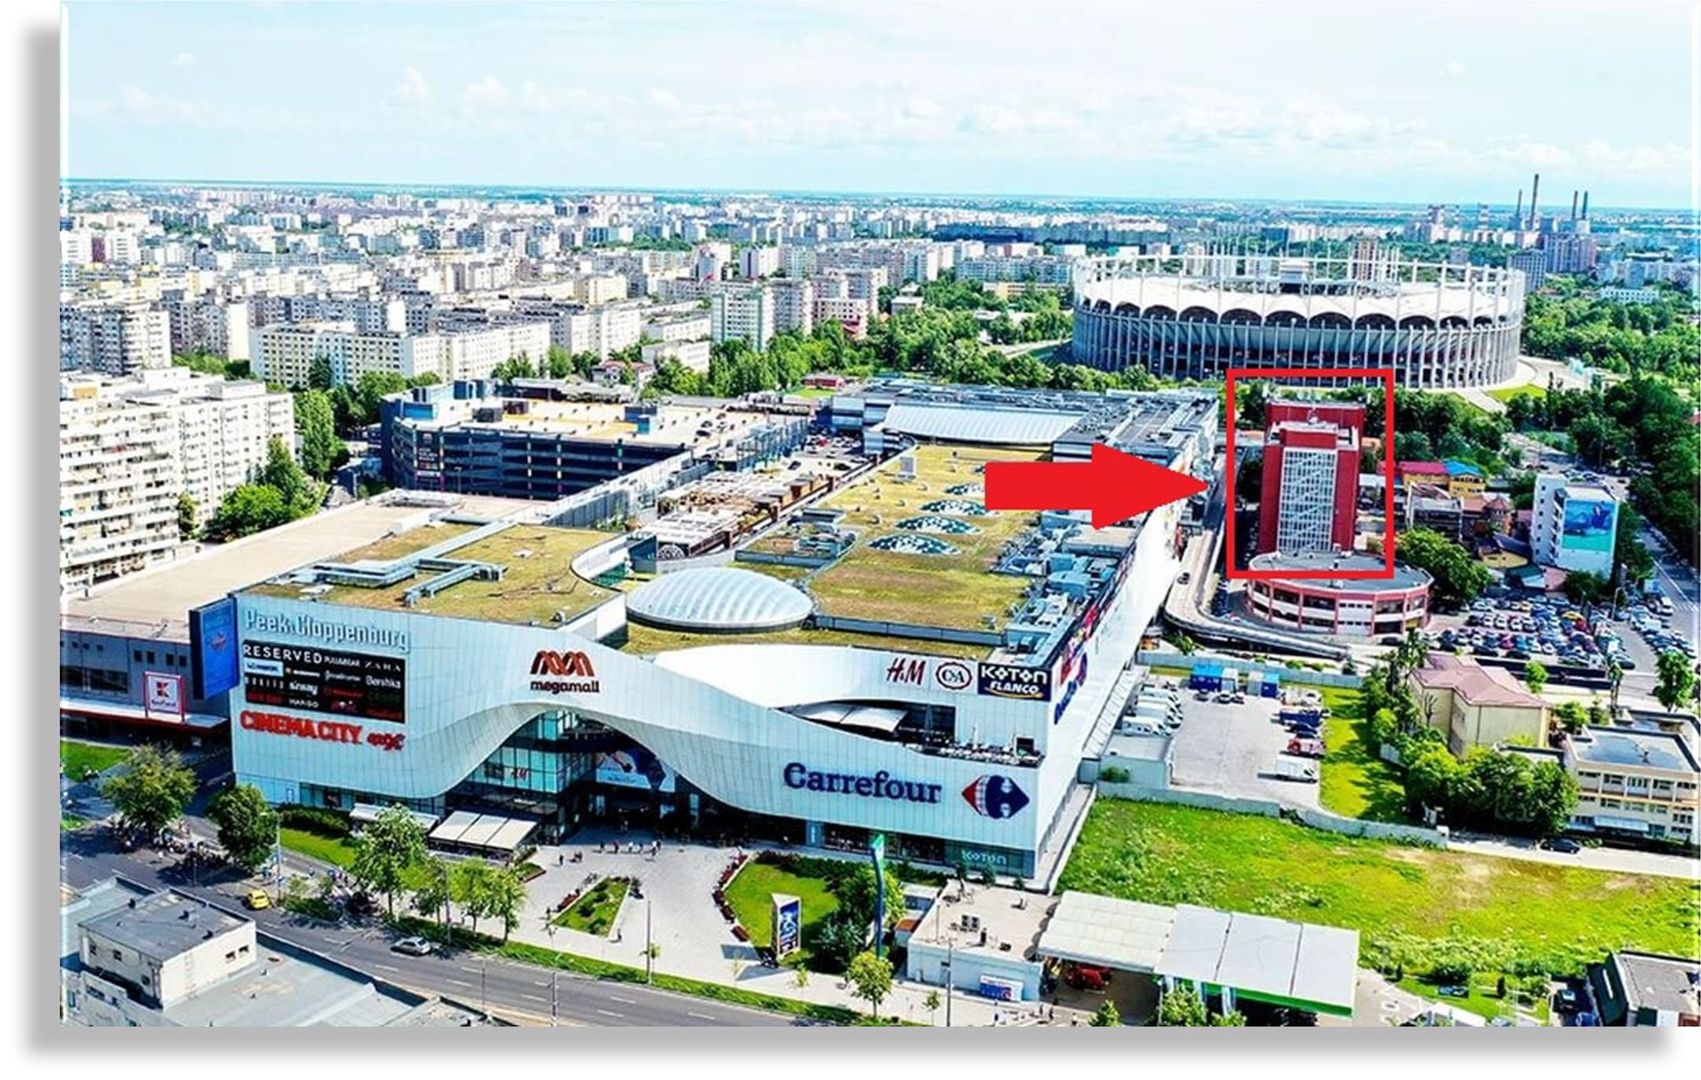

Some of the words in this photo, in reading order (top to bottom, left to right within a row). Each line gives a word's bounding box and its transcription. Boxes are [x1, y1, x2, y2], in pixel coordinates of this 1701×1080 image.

[243, 644, 322, 664] RESERVED
[886, 657, 926, 685] H&M
[365, 674, 402, 689] Bershka
[530, 680, 600, 694] megamall
[990, 681, 1039, 694] FLANCO
[783, 762, 942, 804] Carrefour
